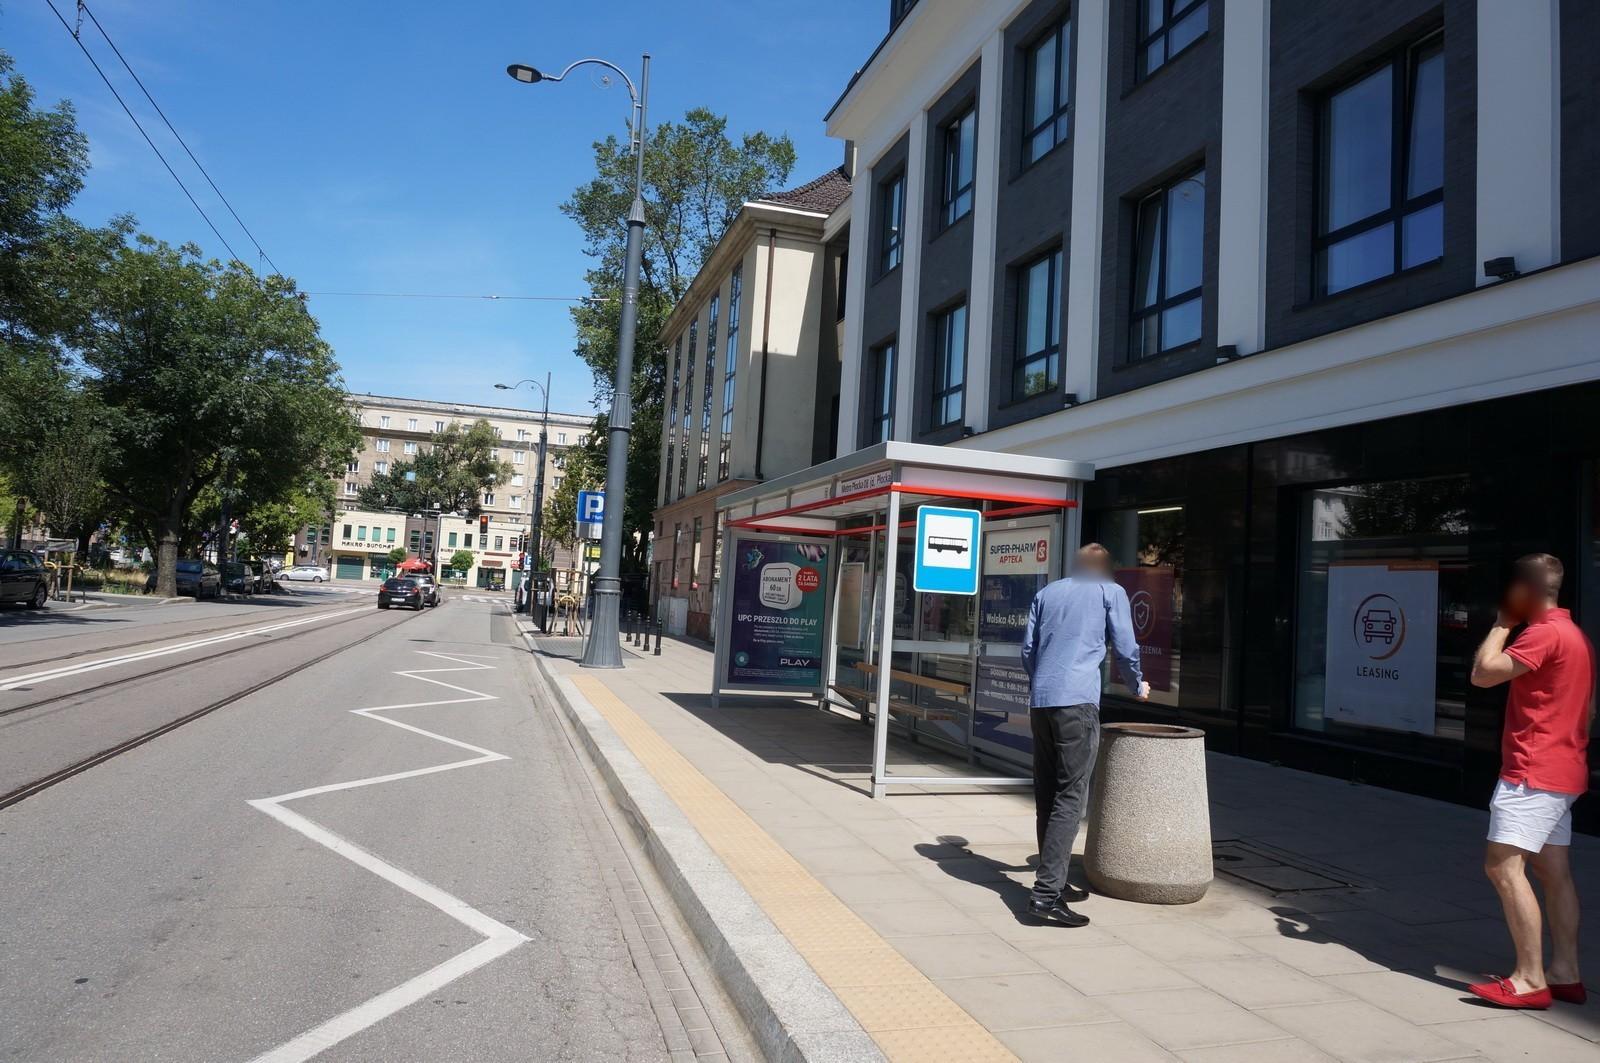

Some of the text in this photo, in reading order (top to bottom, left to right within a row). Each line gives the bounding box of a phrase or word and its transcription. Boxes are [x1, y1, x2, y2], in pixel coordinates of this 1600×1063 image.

[585, 494, 604, 519] P
[990, 542, 1036, 554] SUPER-PHARM
[999, 555, 1023, 564] APTEKA
[738, 614, 752, 622] UPC
[753, 615, 788, 625] PRZESZŁO
[986, 612, 1006, 624] Wolska
[780, 658, 810, 667] PLAY
[1356, 666, 1399, 680] LEASING
